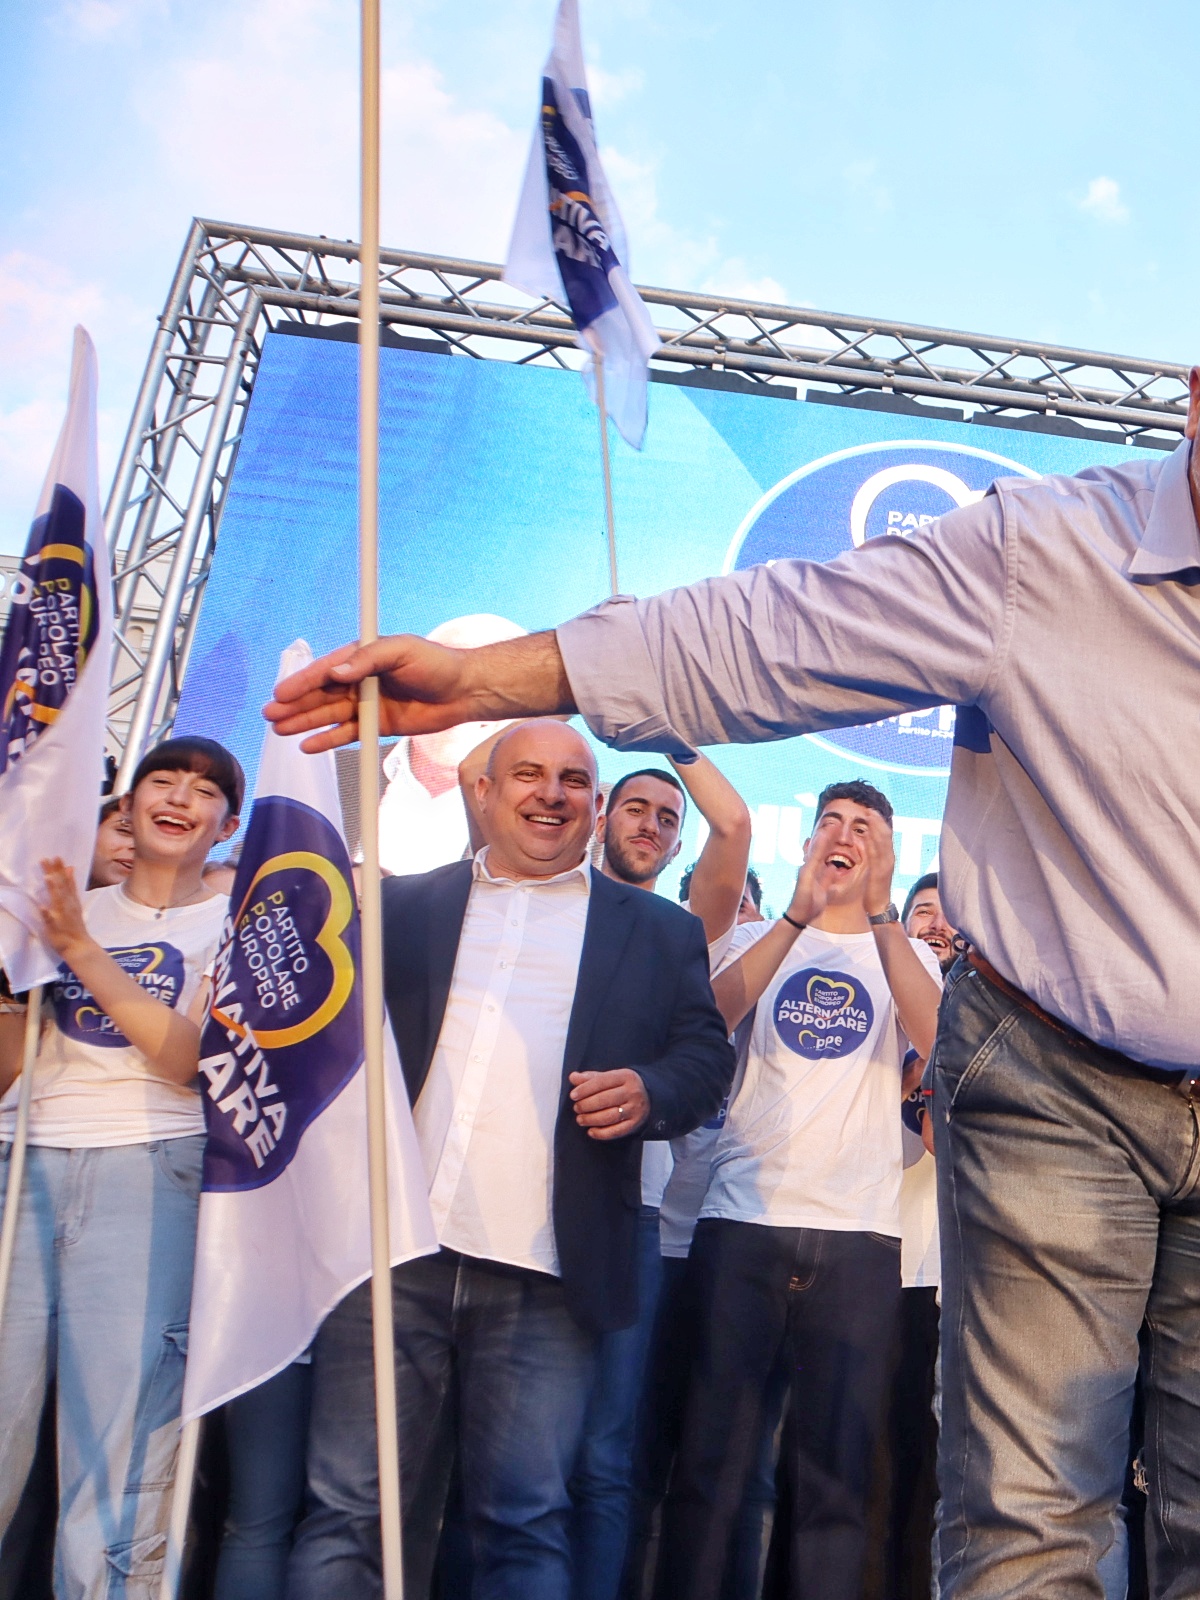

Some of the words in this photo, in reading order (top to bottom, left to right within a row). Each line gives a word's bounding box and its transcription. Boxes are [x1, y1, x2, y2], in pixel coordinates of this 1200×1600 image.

[239, 916, 277, 1009] EUROPEO
[250, 901, 300, 1011] POPOLARE
[267, 890, 309, 973] PARTITO
[213, 915, 288, 1141] ERNATIVA
[778, 1010, 867, 1032] POPOLARE
[780, 1000, 867, 1020] ALTERNATIVA
[816, 1035, 843, 1049] ppe
